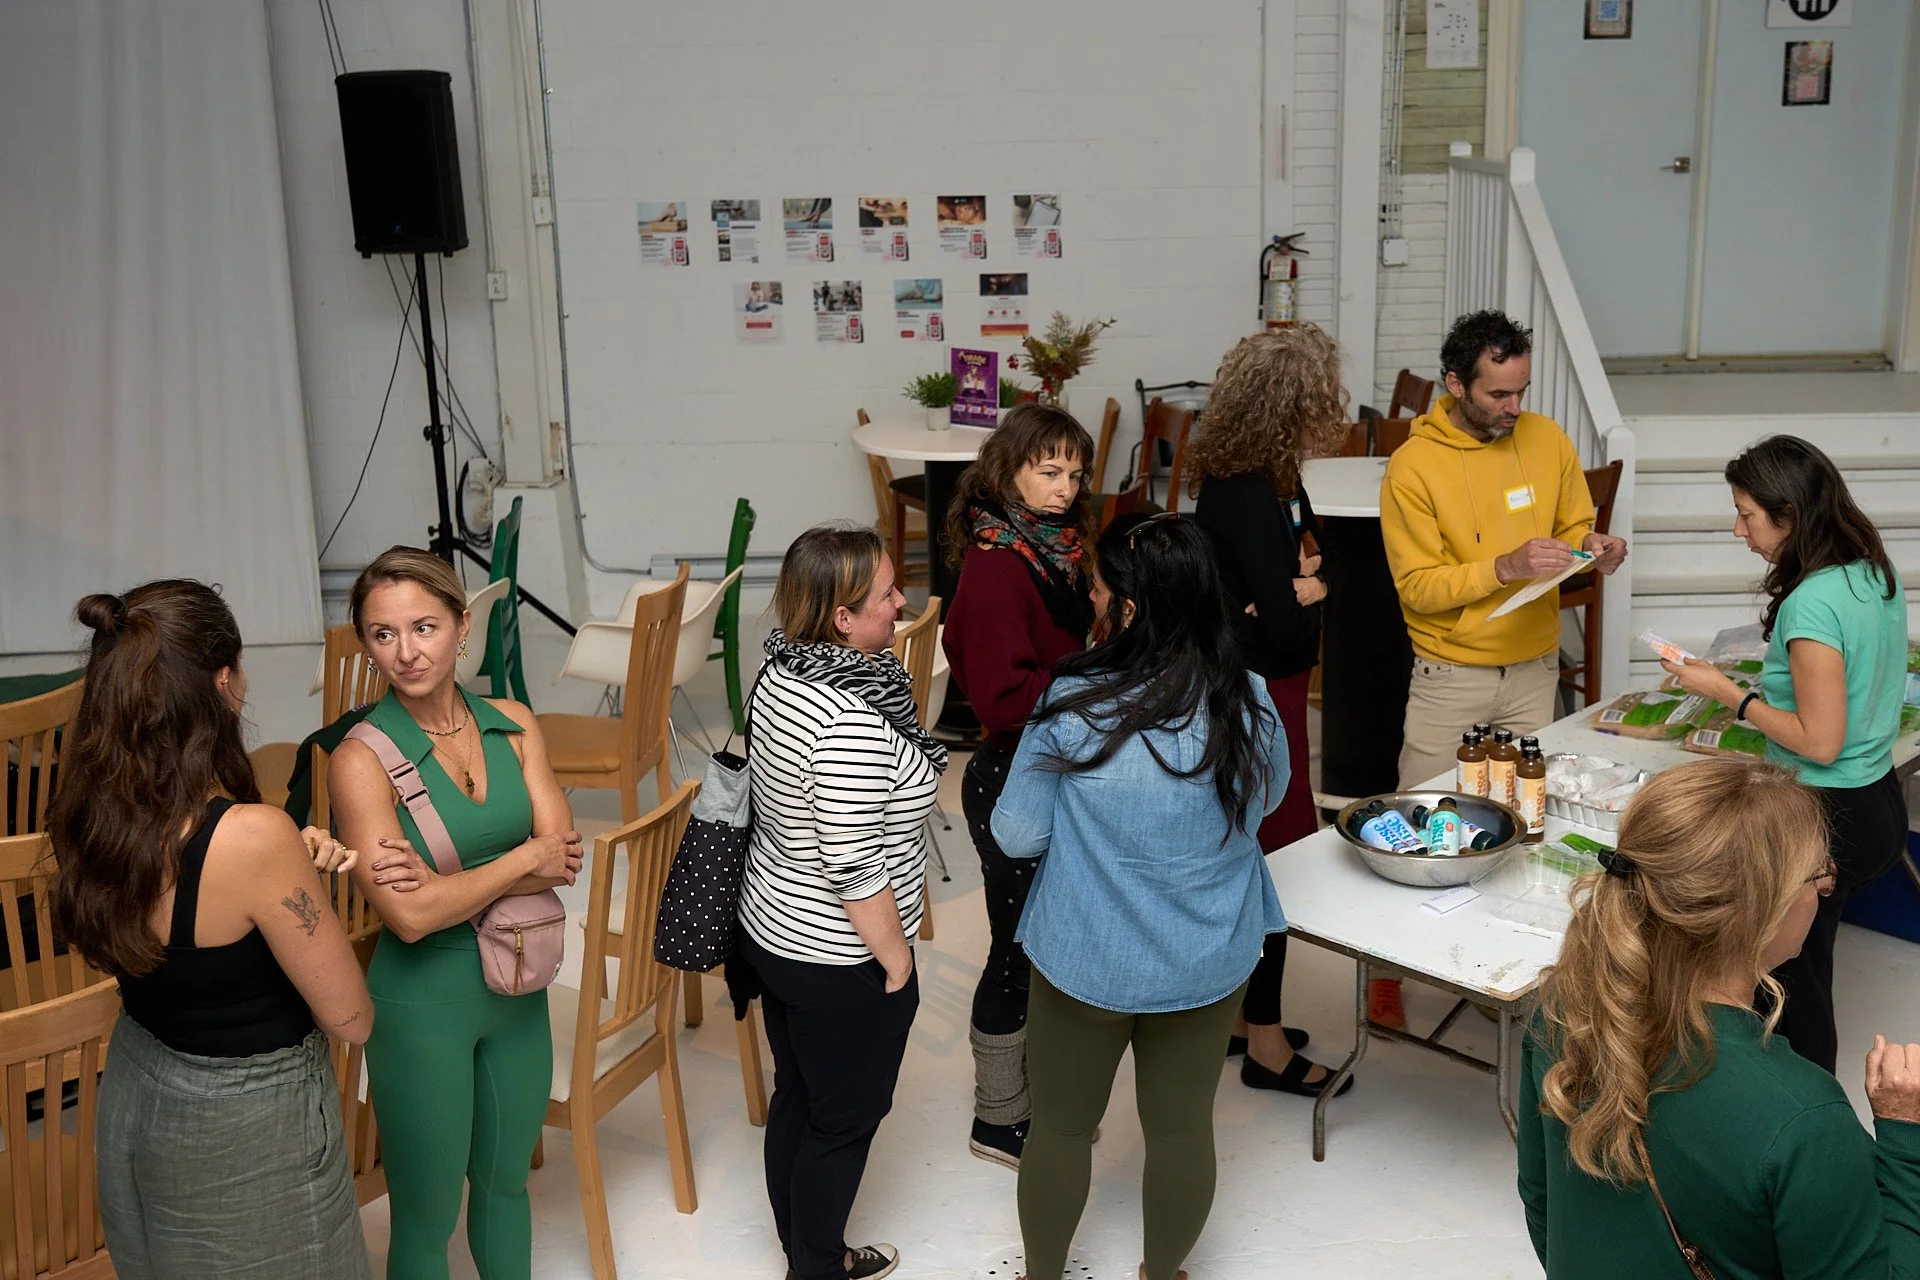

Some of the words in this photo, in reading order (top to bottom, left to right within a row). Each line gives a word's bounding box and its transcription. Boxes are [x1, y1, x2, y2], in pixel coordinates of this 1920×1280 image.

[1374, 822, 1400, 845] rise
[1387, 816, 1413, 841] rise
[1431, 818, 1445, 844] rise
